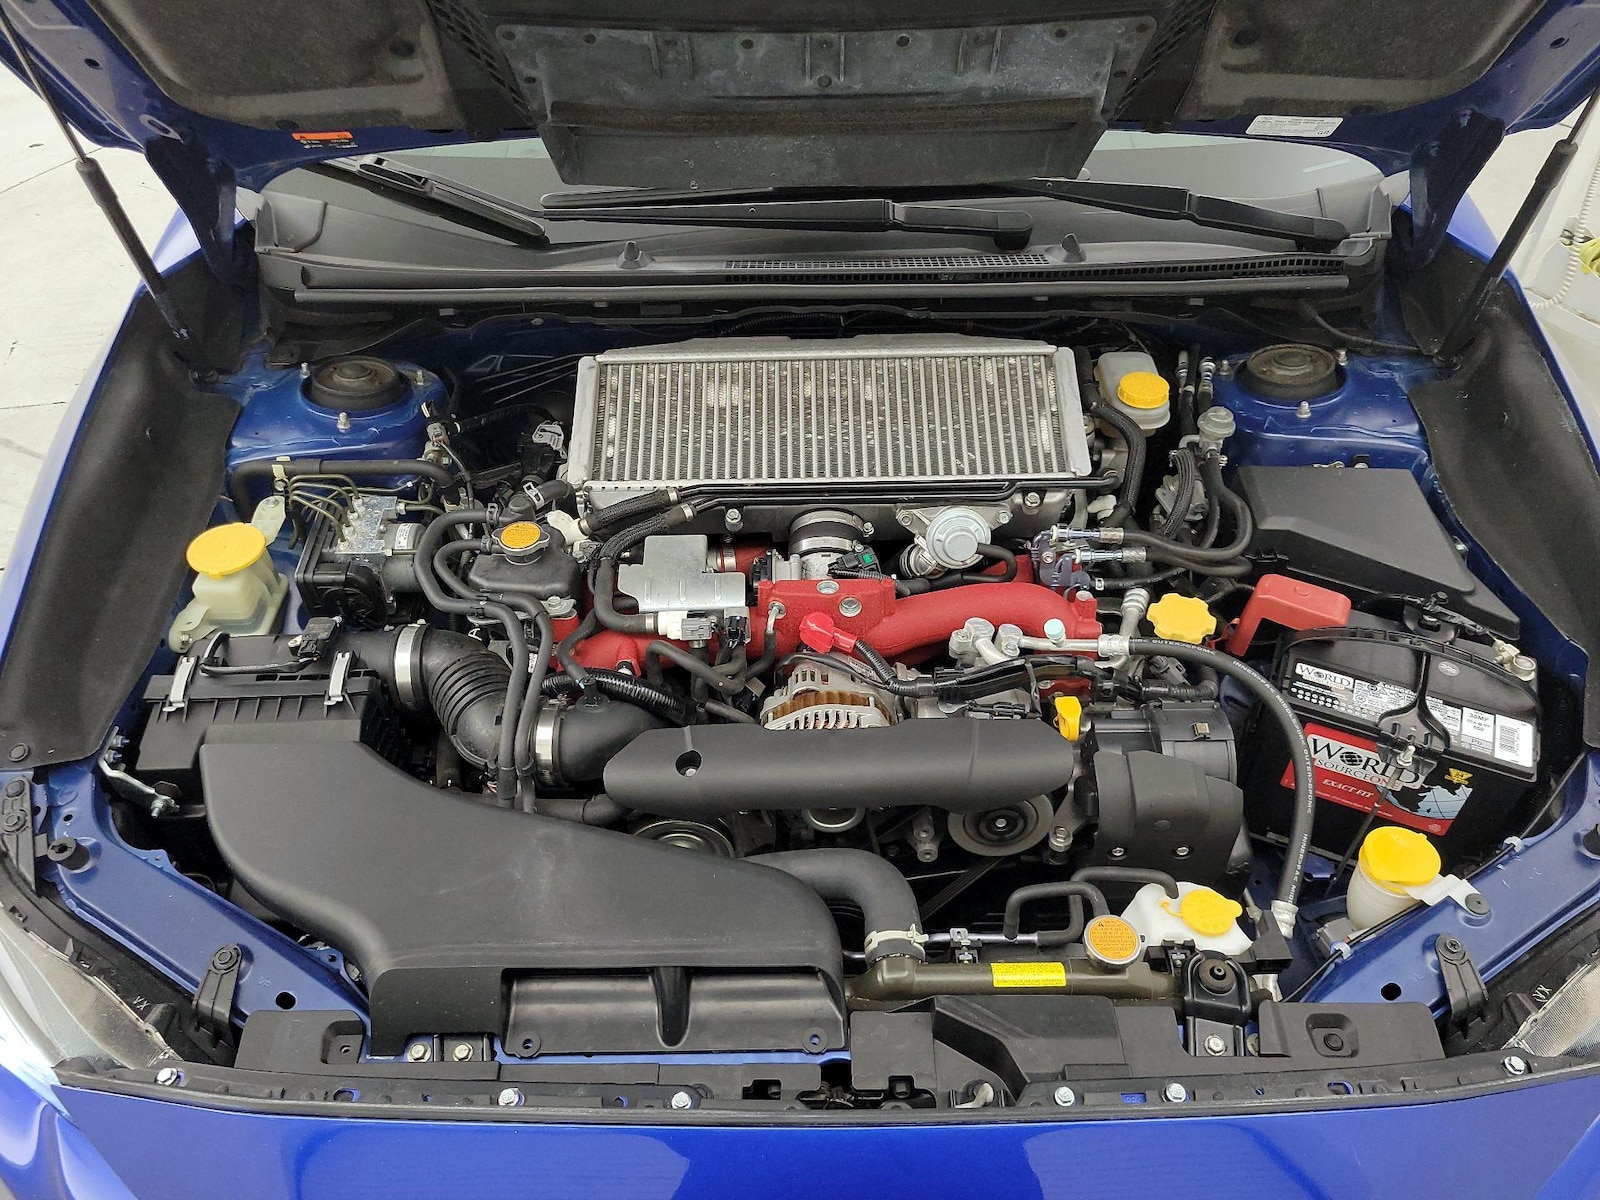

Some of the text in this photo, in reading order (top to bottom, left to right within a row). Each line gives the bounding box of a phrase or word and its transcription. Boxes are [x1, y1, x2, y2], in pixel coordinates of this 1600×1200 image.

[1298, 663, 1351, 687] WORLD
[1322, 778, 1375, 799] EXACT FIT
